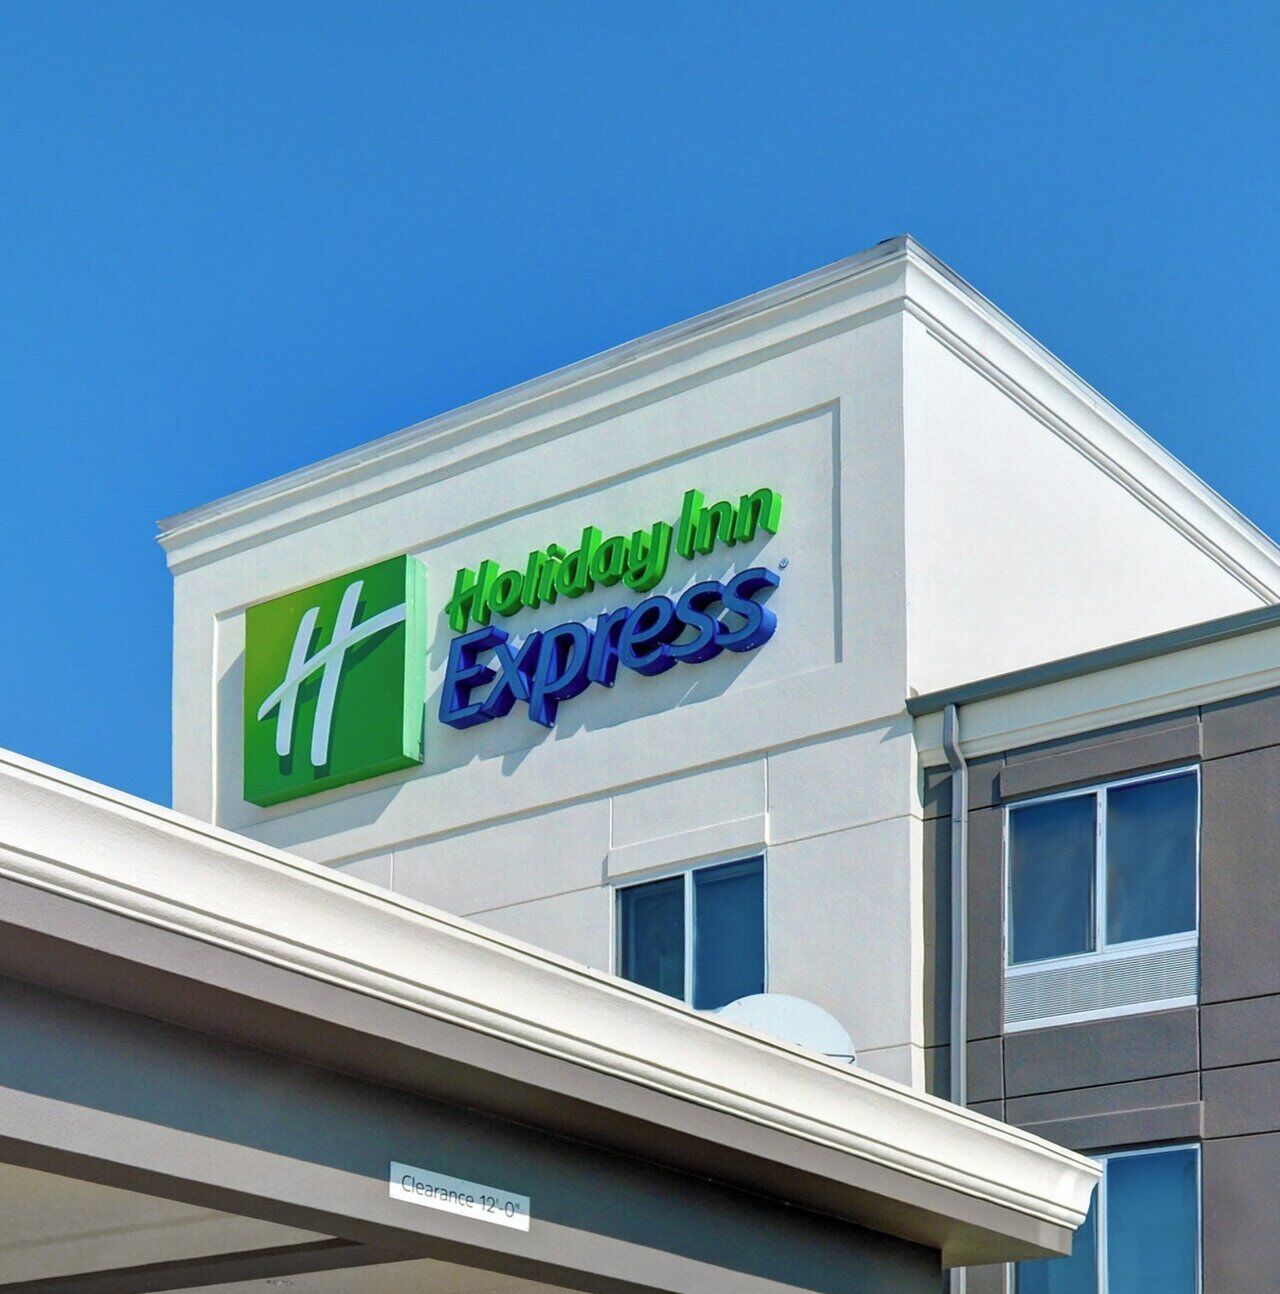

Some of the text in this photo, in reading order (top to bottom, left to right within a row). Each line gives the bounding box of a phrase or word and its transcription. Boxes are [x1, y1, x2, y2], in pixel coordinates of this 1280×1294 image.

[445, 487, 782, 632] Holiday Inn
[438, 566, 781, 728] Express
[401, 1174, 474, 1208] Clearance
